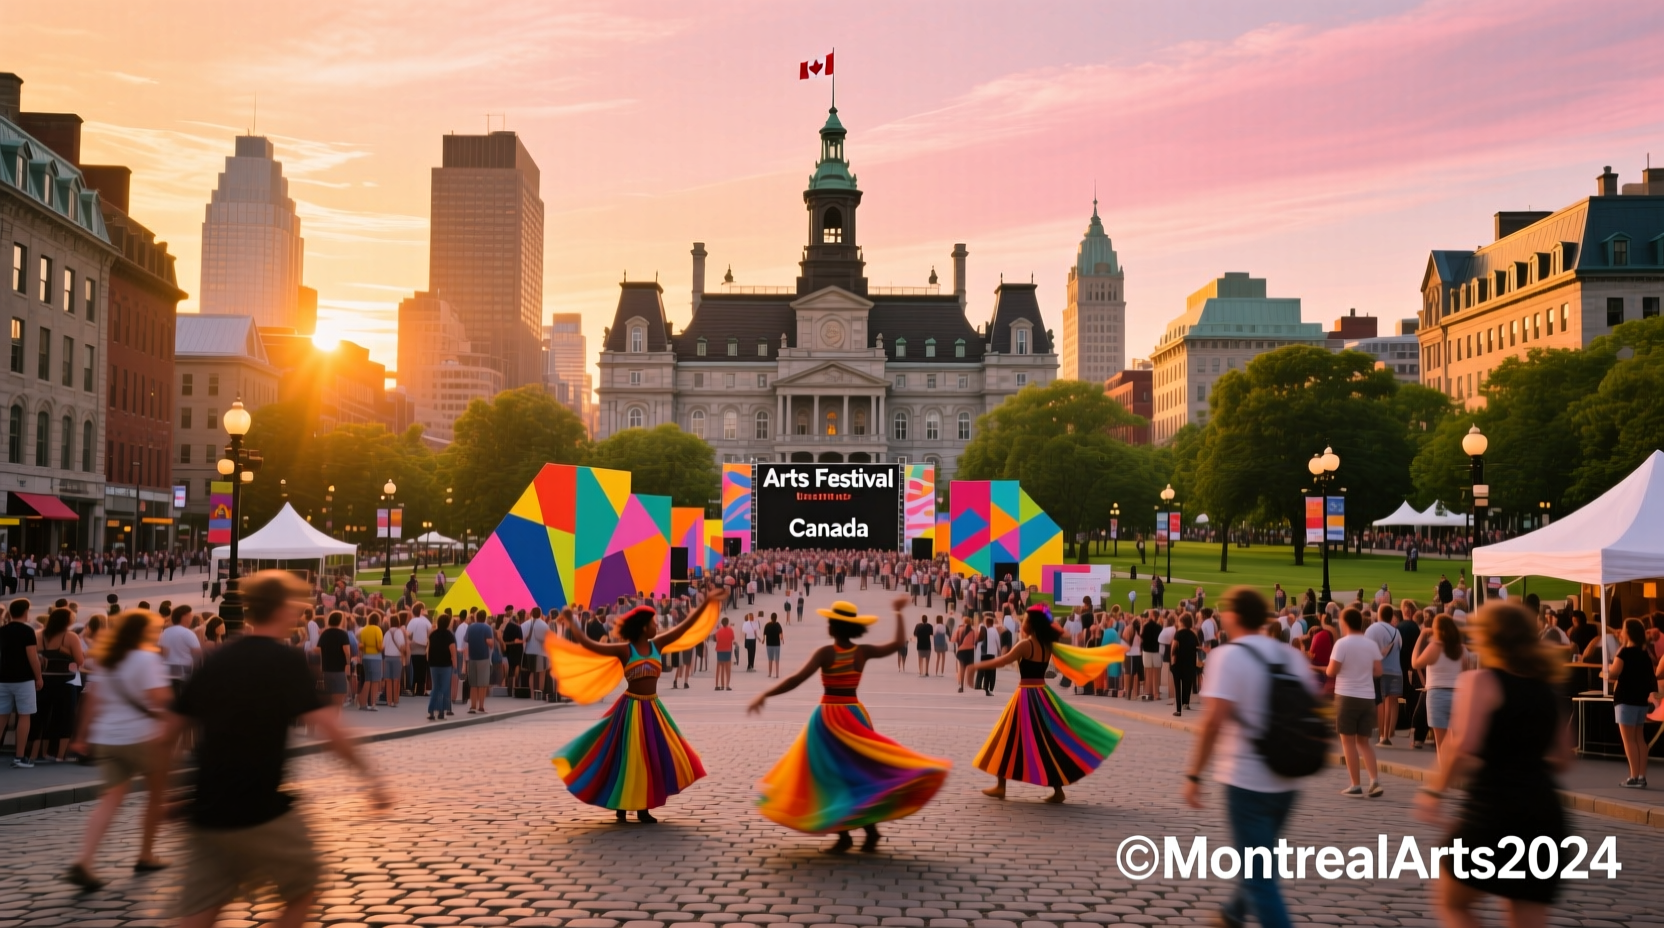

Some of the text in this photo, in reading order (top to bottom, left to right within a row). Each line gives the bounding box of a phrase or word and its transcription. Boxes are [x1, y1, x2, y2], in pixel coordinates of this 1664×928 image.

[762, 467, 894, 488] Arts Festival
[788, 517, 869, 538] Canada
